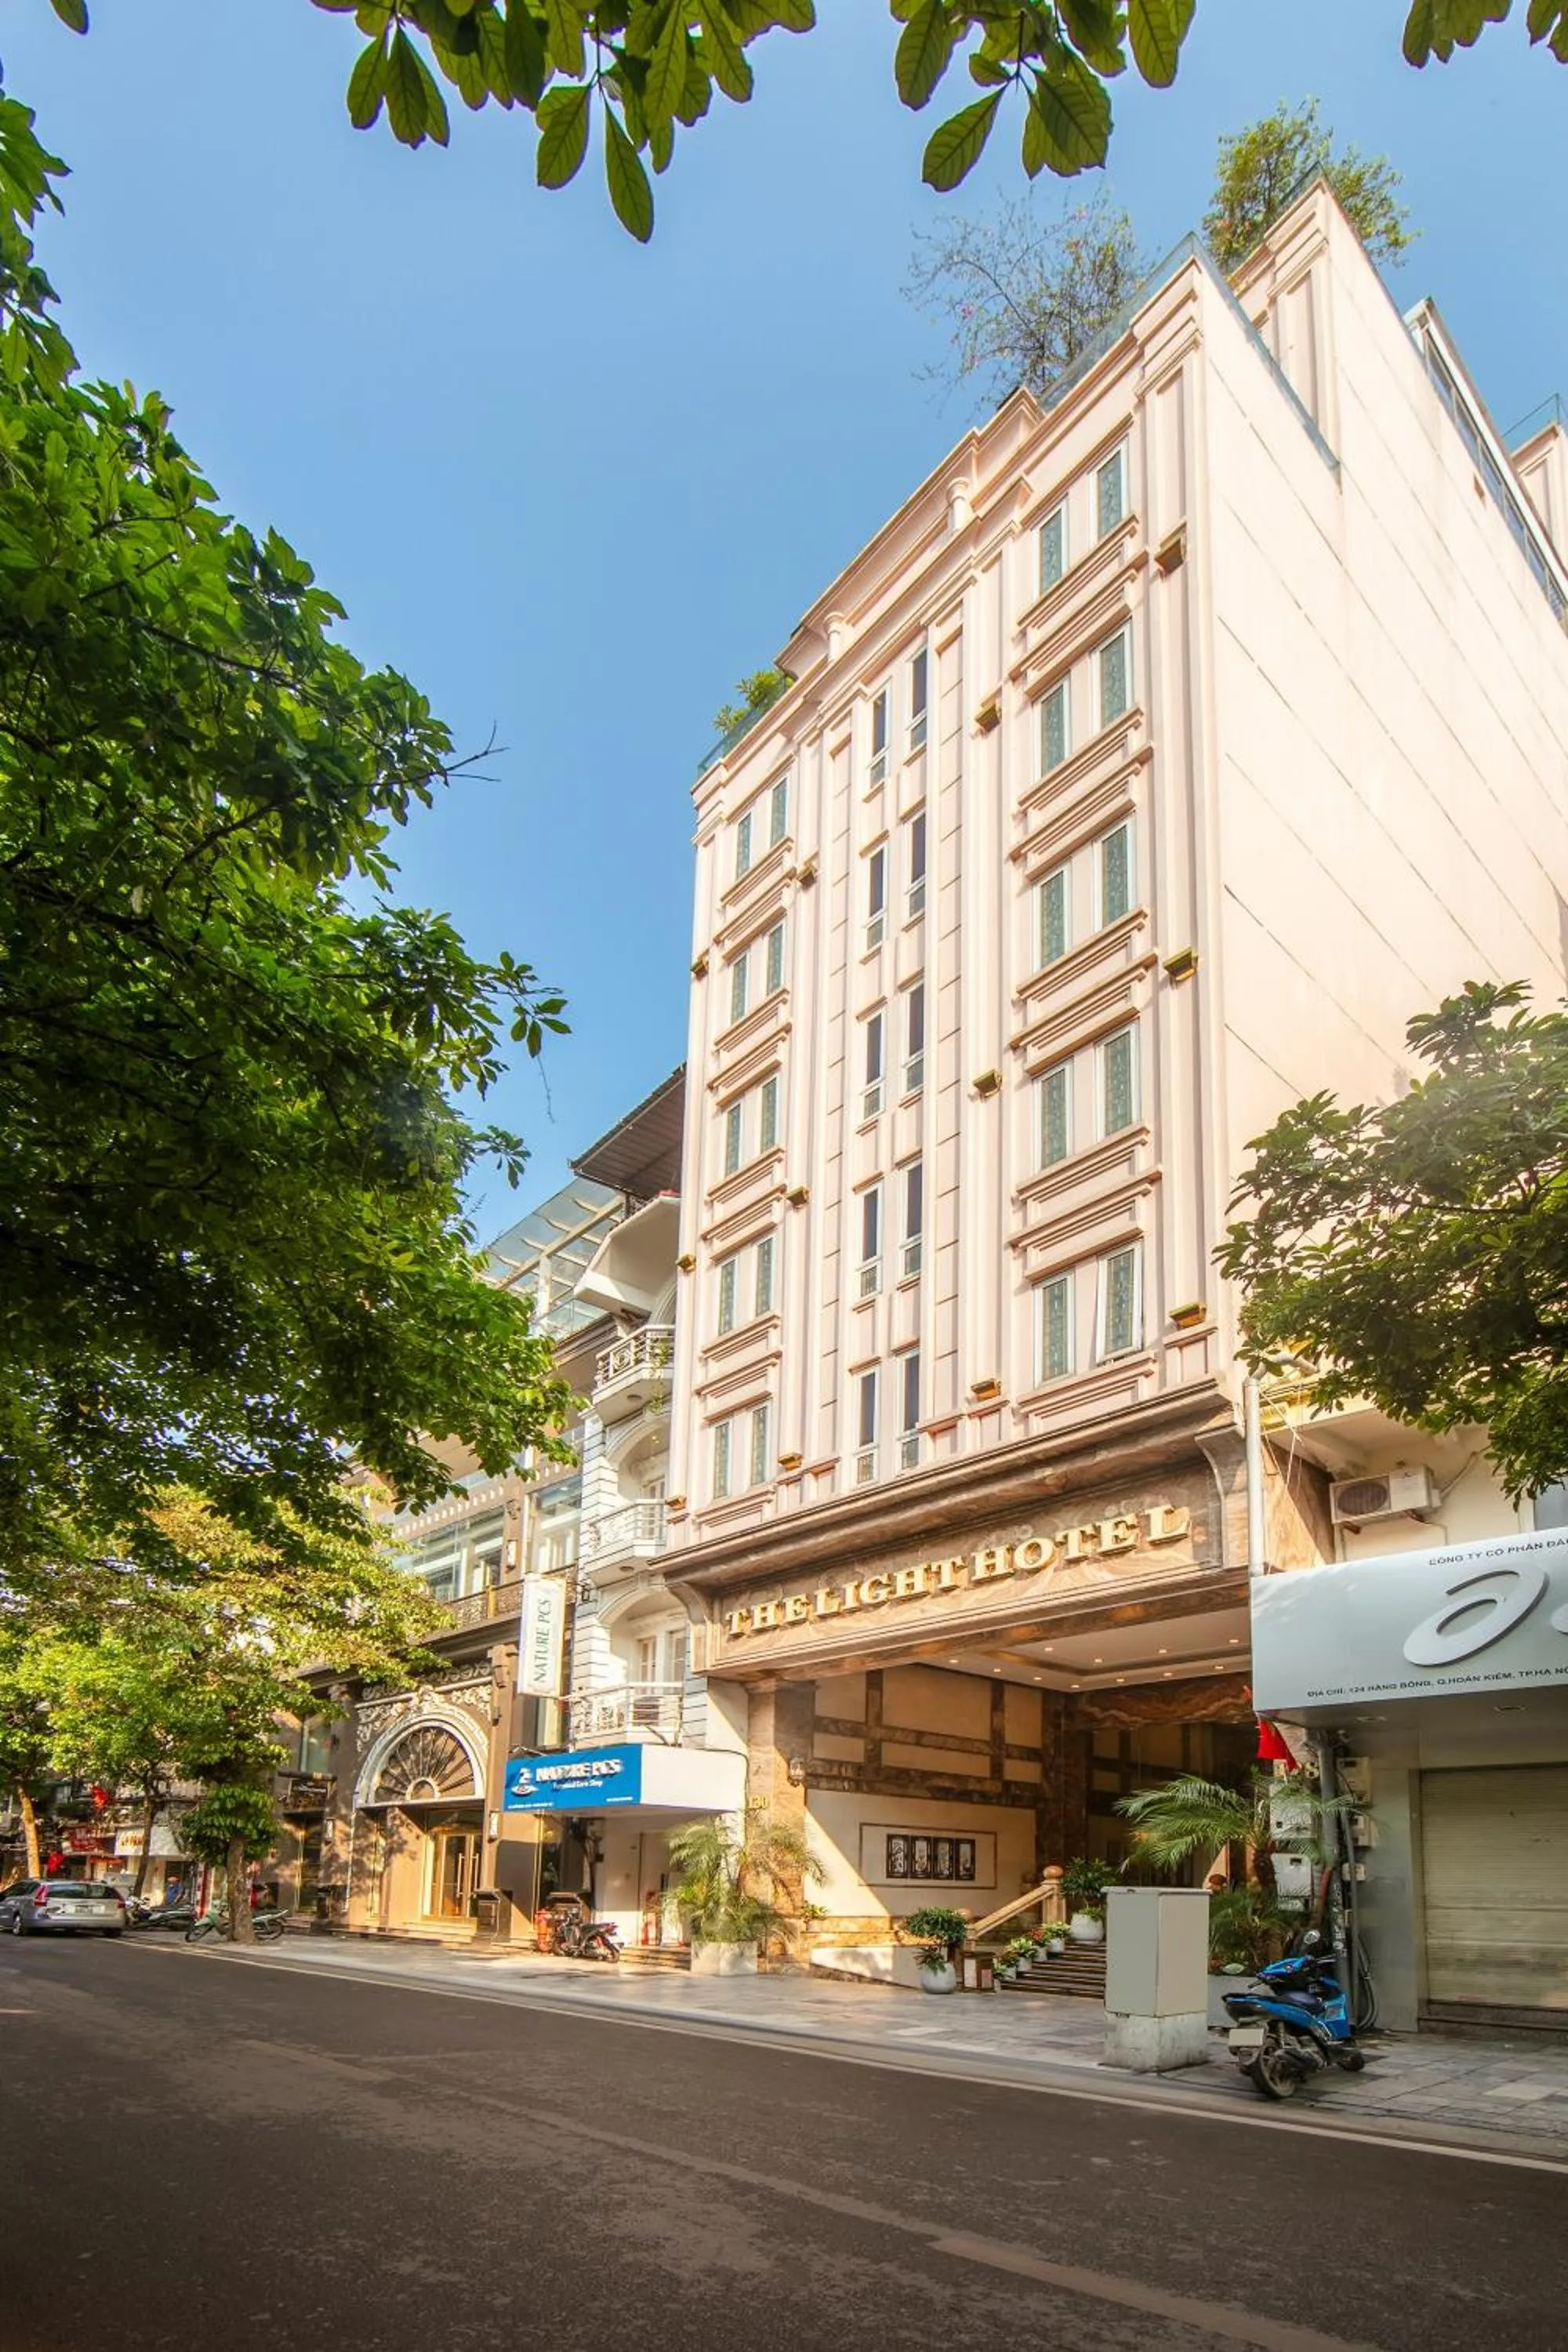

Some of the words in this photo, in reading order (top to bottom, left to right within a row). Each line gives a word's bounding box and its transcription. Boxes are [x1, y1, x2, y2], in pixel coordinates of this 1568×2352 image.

[725, 1594, 812, 1639] THE
[812, 1553, 969, 1619] LIGHT
[970, 1504, 1193, 1584] HOTEL
[537, 1599, 551, 1624] PCS
[534, 1627, 550, 1683] NATURE
